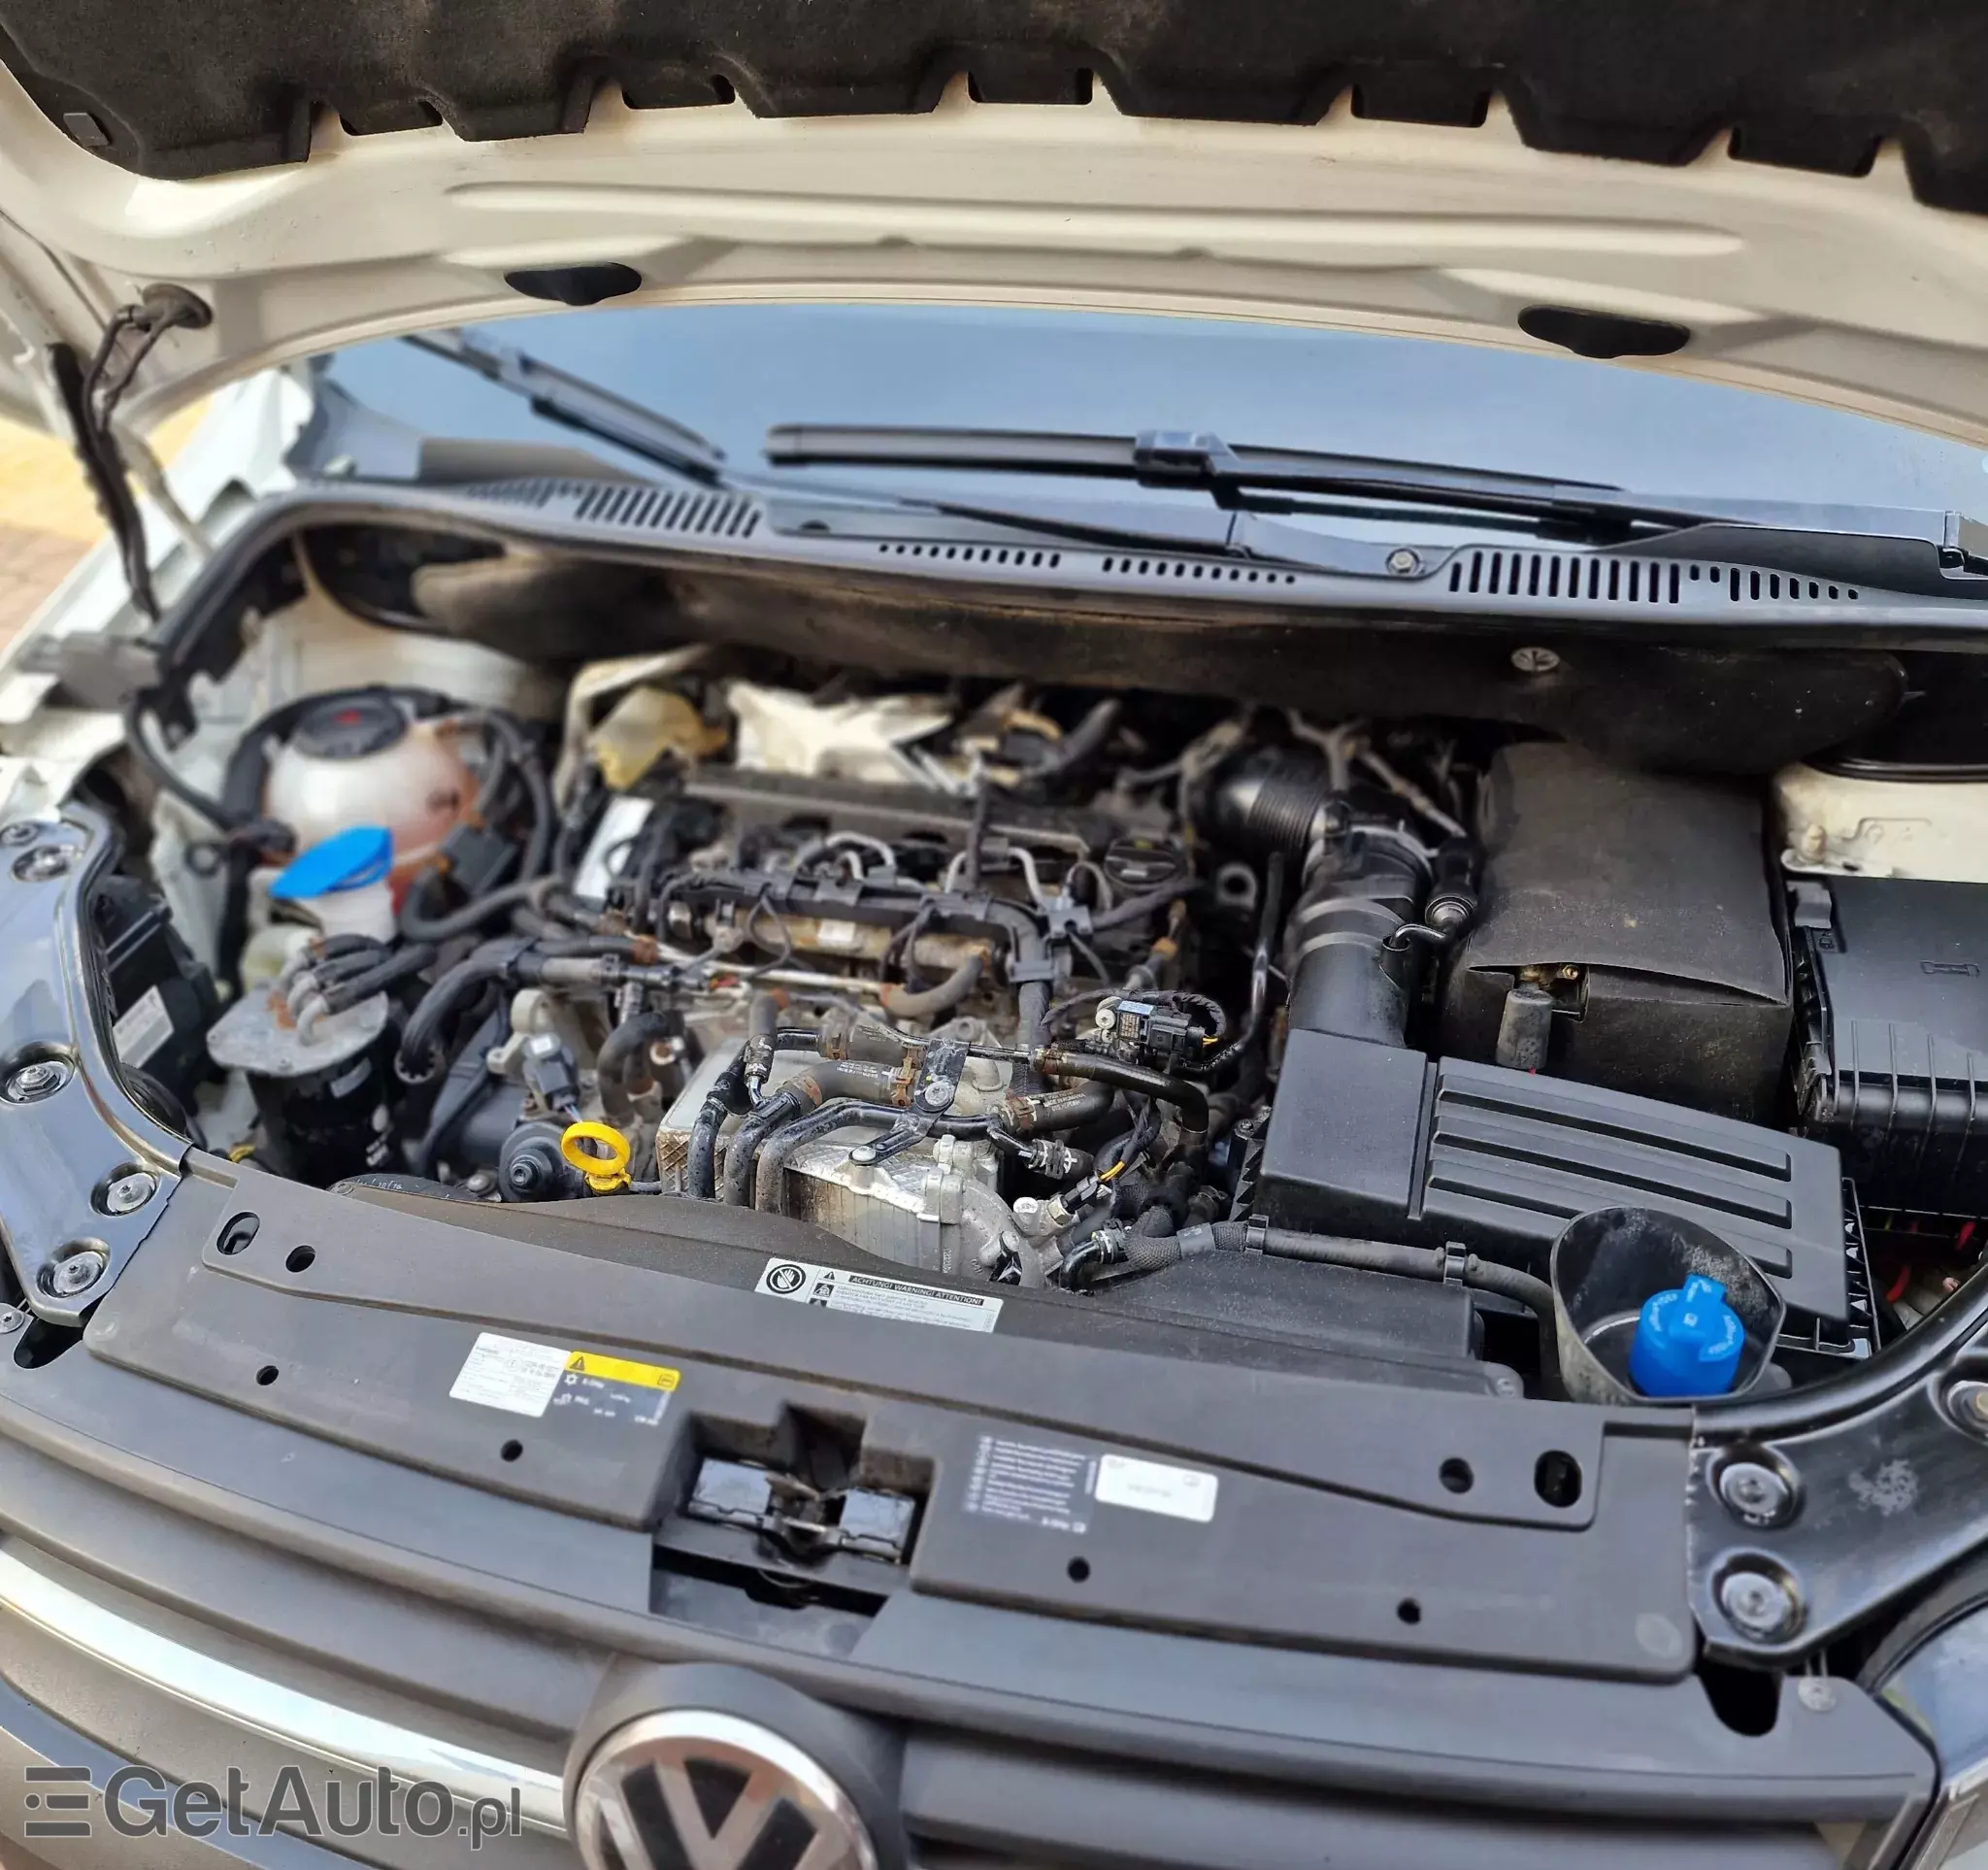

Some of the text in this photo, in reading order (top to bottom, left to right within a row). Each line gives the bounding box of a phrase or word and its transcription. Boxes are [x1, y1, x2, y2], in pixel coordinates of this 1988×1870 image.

[851, 1276, 892, 1288] ACHTUNG!
[894, 1284, 935, 1297] WARNING!
[934, 1290, 981, 1306] ATTENTION!
